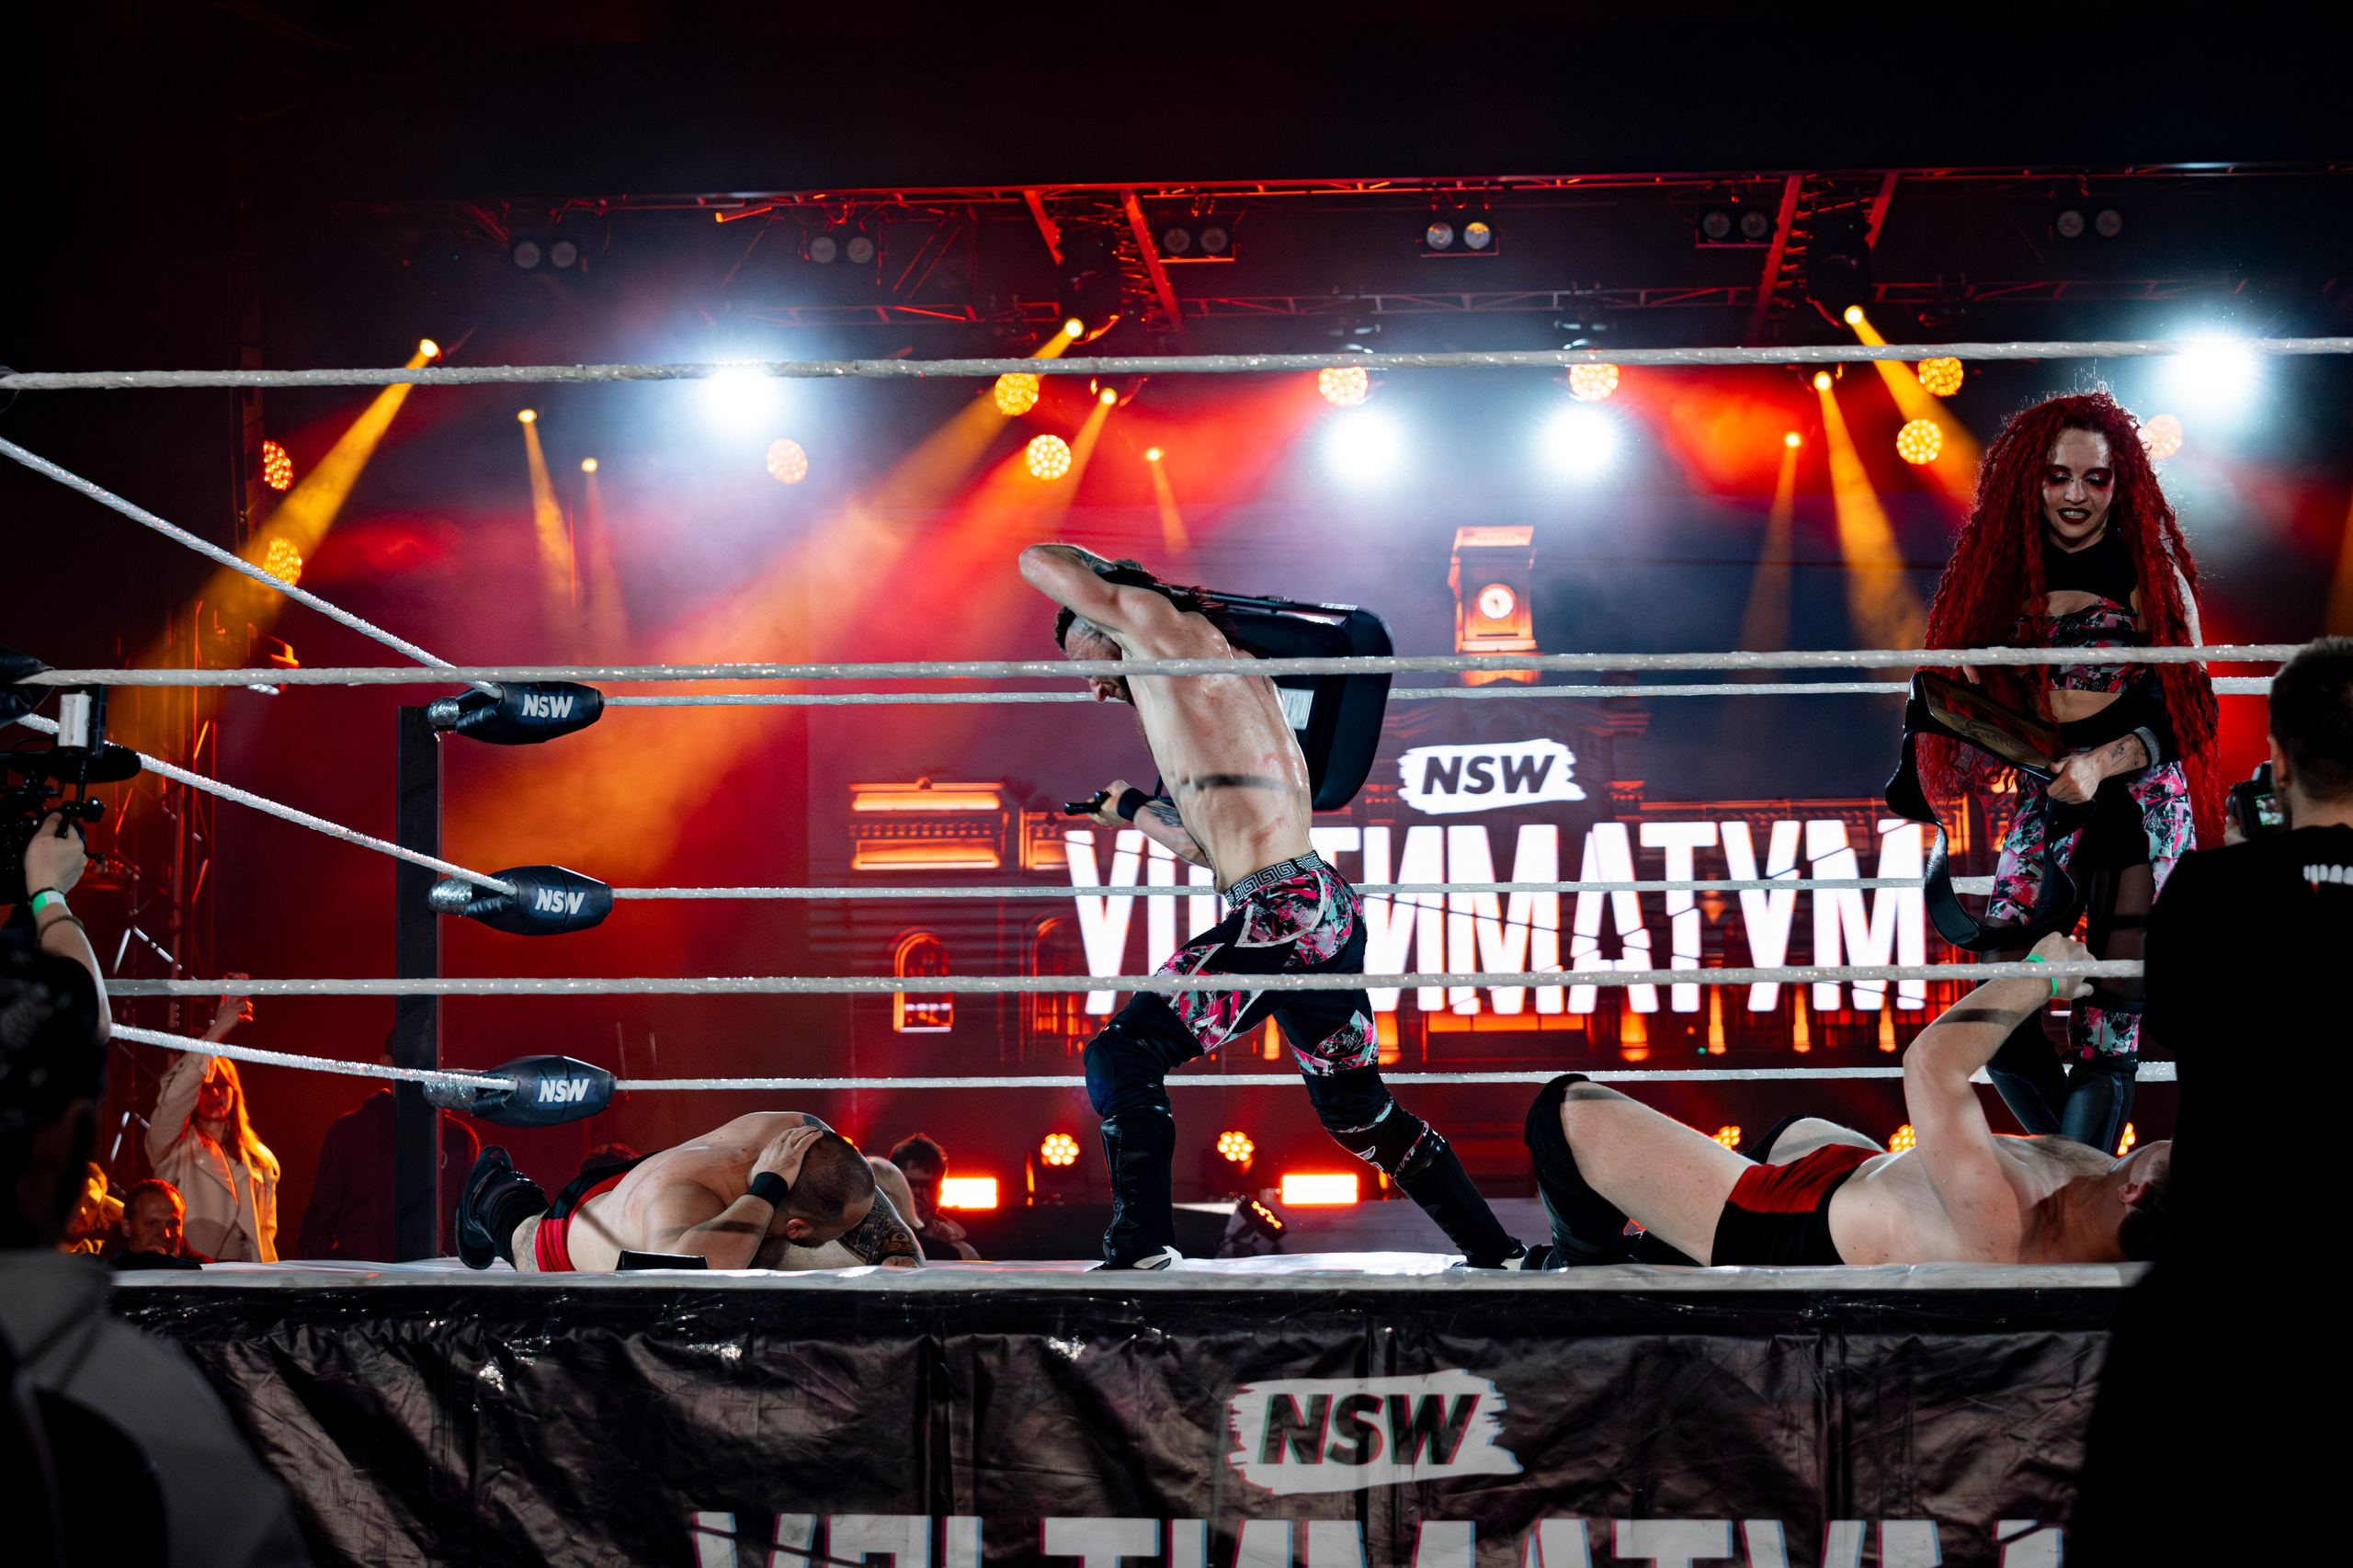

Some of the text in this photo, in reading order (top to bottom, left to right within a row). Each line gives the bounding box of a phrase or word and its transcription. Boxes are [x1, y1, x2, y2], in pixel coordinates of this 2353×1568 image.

[521, 693, 574, 719] NSW
[1421, 755, 1556, 795] NSW
[534, 888, 585, 915] NSW
[1063, 818, 1928, 1016] УИМАТУМ
[538, 1077, 589, 1103] NSW
[1256, 1392, 1482, 1466] NSW
